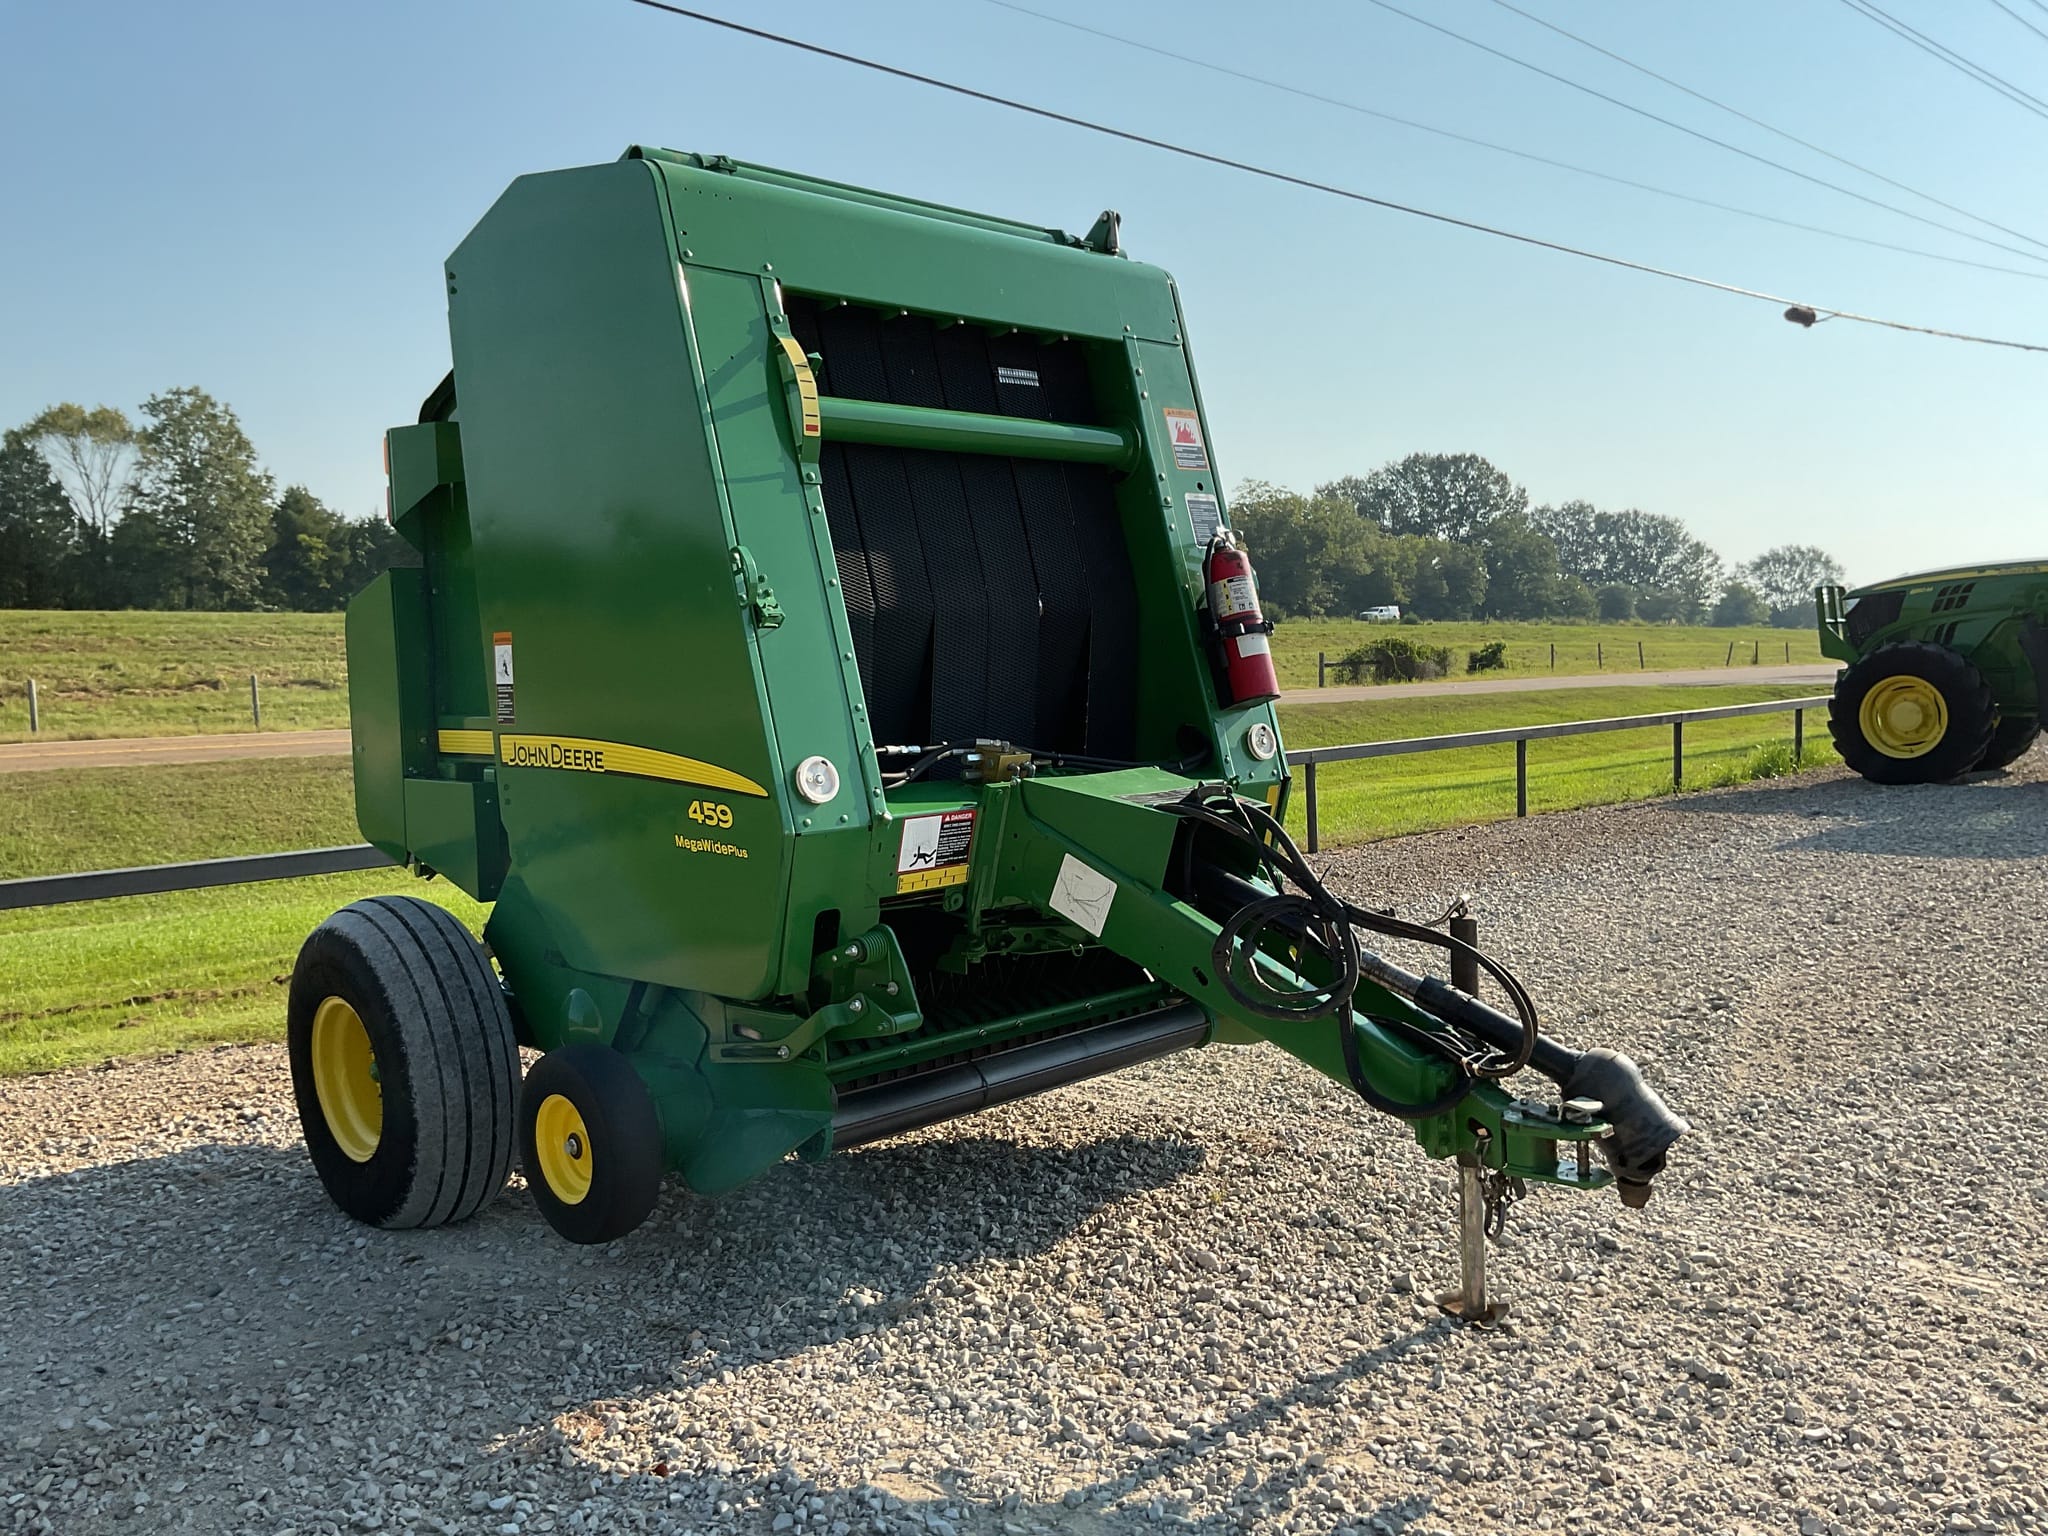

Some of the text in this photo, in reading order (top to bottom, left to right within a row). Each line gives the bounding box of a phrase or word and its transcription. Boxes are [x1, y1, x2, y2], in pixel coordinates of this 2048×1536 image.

[509, 741, 605, 769] JOHN DEERE
[688, 800, 733, 828] 459
[674, 834, 748, 858] MegaWidePlus
